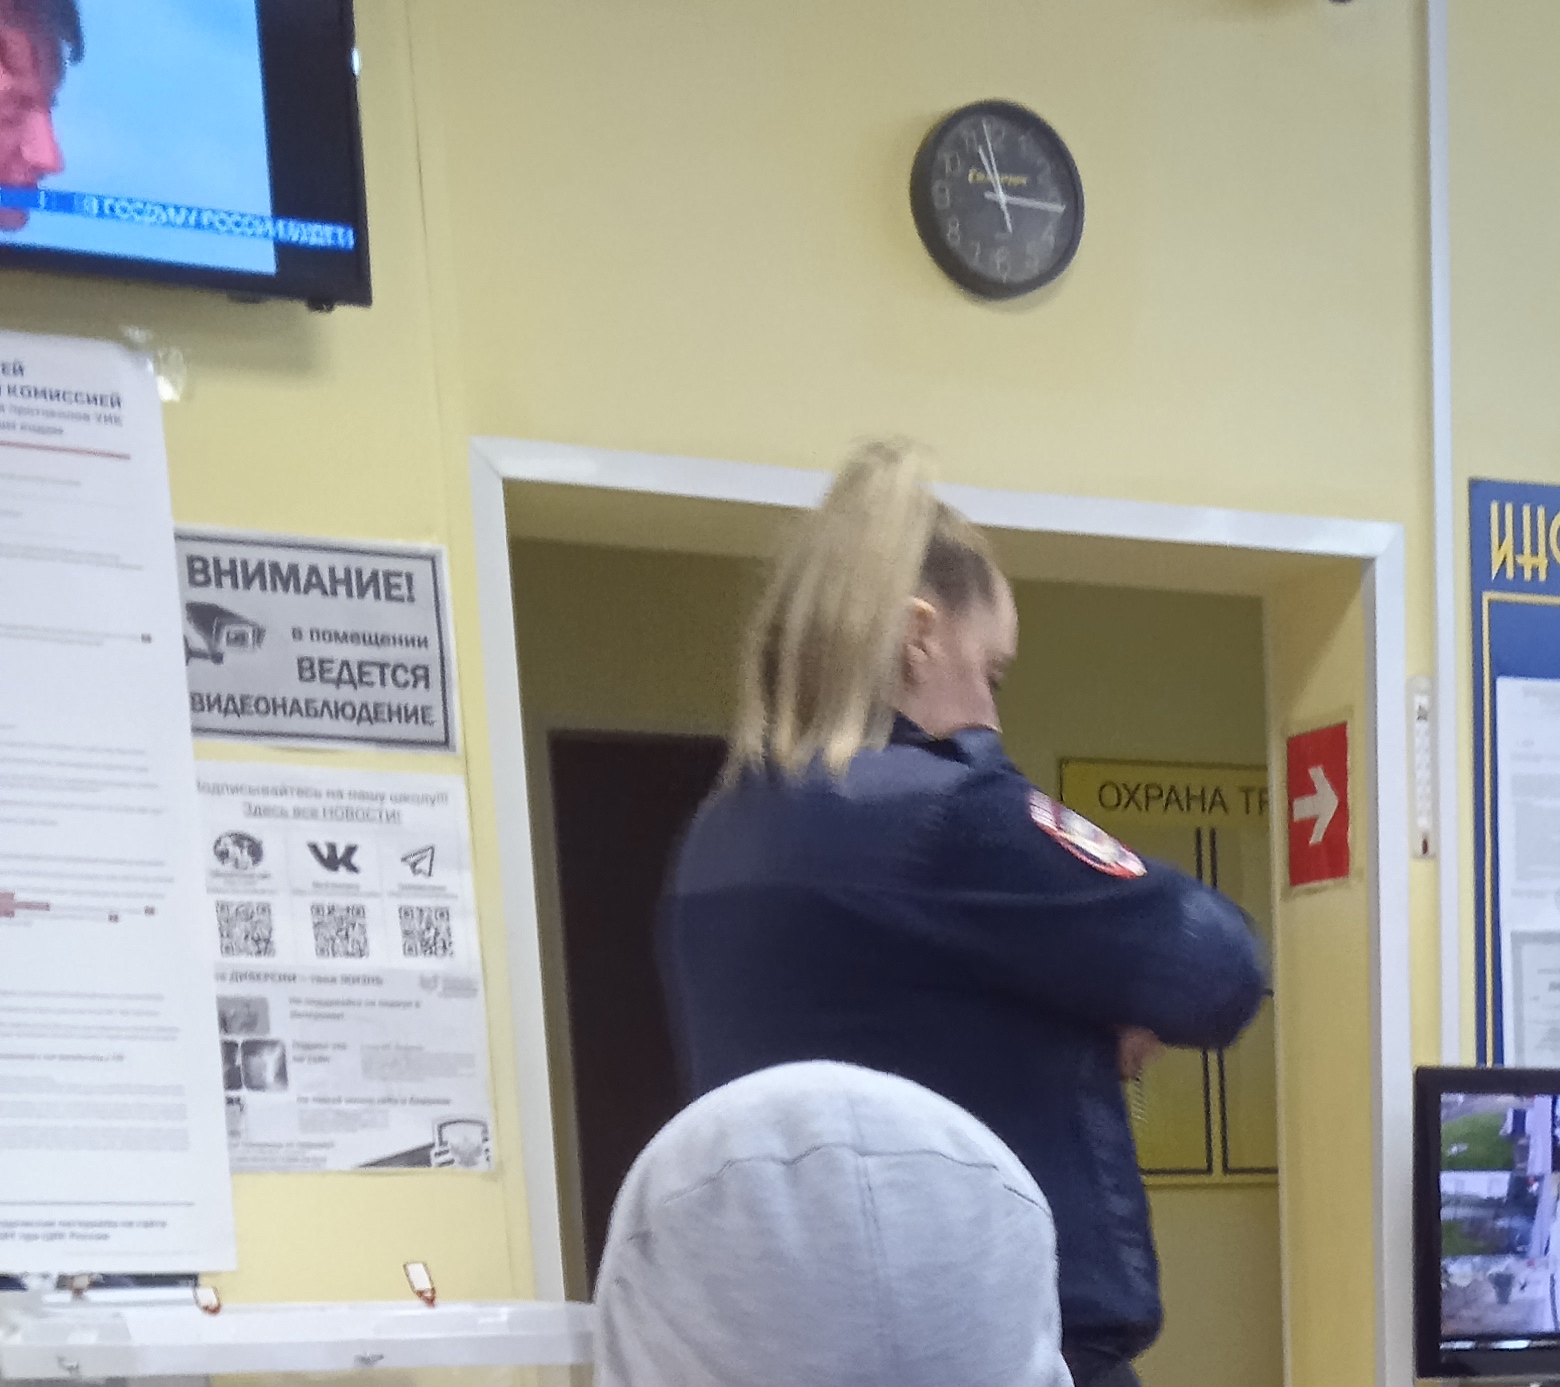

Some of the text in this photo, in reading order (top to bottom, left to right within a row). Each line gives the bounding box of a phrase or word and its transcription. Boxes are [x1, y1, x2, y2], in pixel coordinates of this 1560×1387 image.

[7, 383, 122, 409] КОМИССИЕЙ
[186, 553, 416, 603] ВНИМАНИЕ!
[309, 626, 429, 649] помещении
[296, 655, 431, 692] ВЕДЕТСЯ
[190, 691, 435, 727] ВИДЕОНАБЛЮДЕНИЕ
[1098, 780, 1229, 815] ОХРАНА
